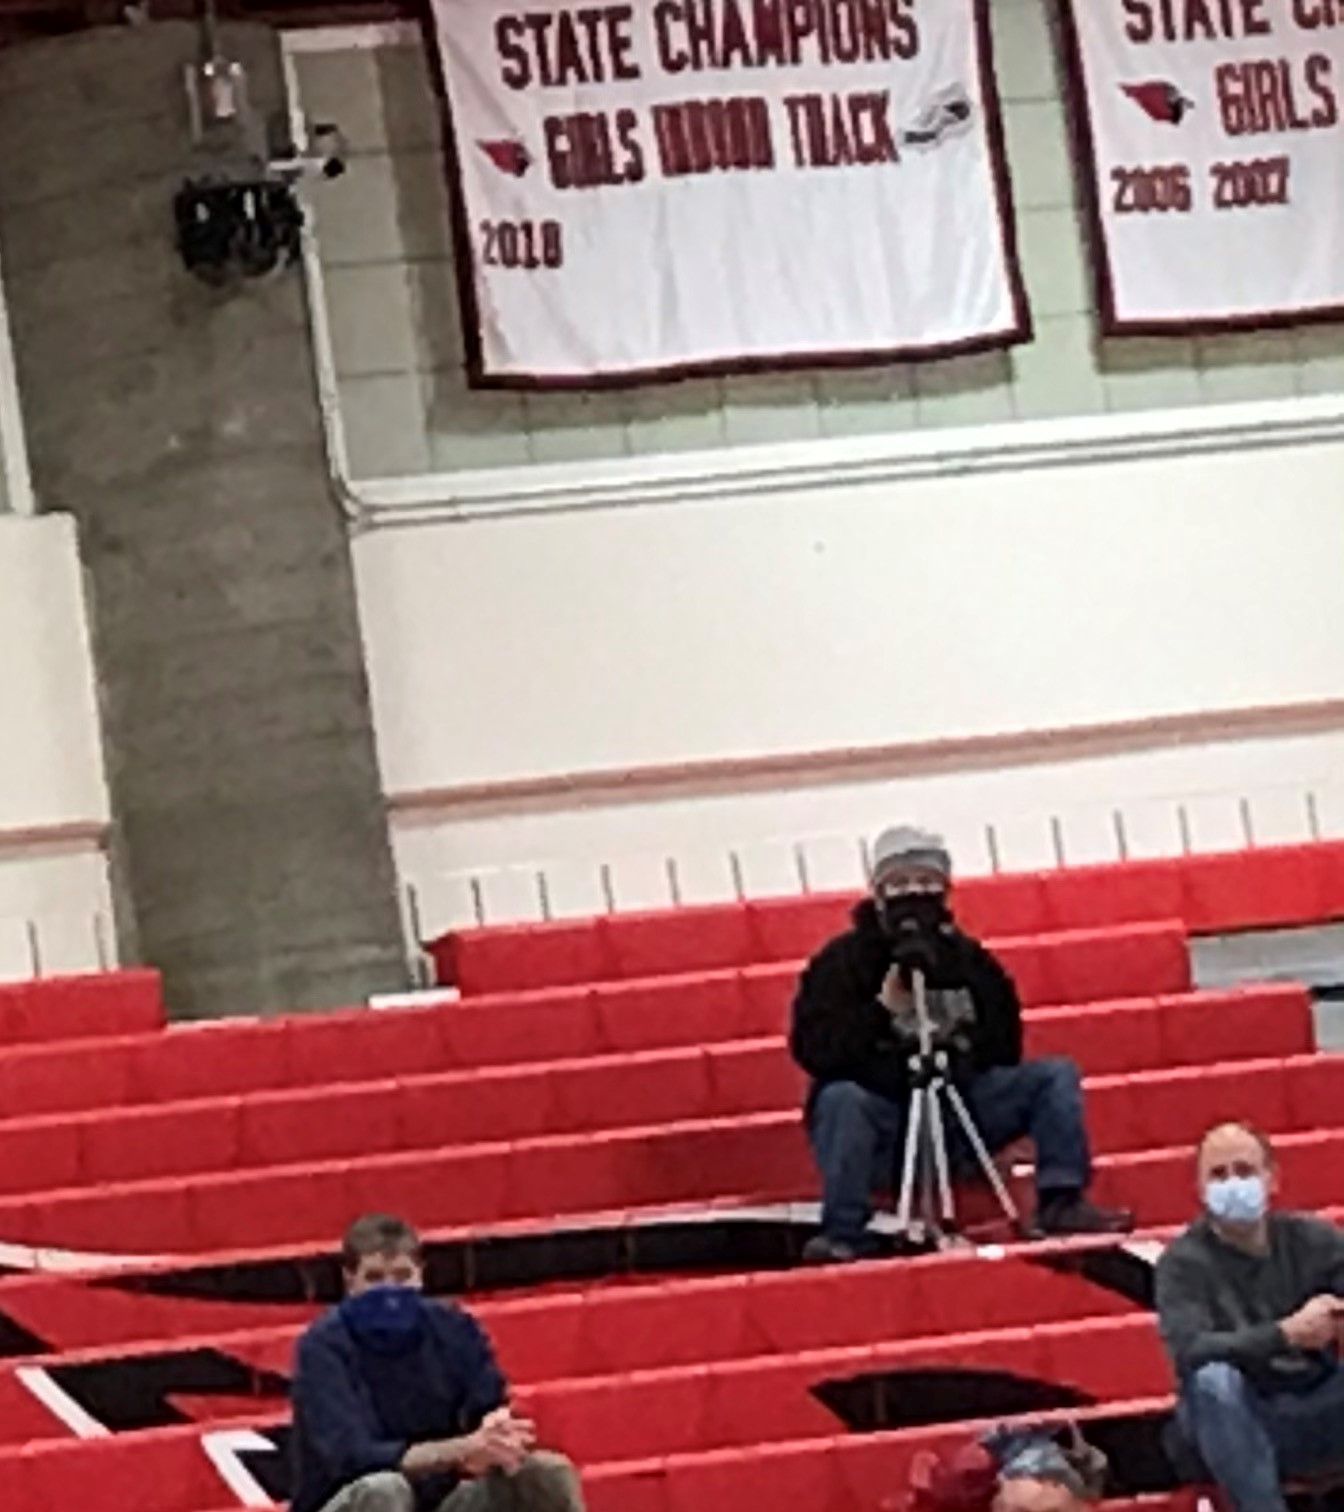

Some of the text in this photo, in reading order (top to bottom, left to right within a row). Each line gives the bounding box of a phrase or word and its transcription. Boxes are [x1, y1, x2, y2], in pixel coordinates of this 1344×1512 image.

[495, 0, 919, 90] STATE CHAMPIONS
[543, 108, 645, 189] GIRLS
[783, 90, 900, 167] TRACK
[1215, 53, 1337, 136] GIRLS
